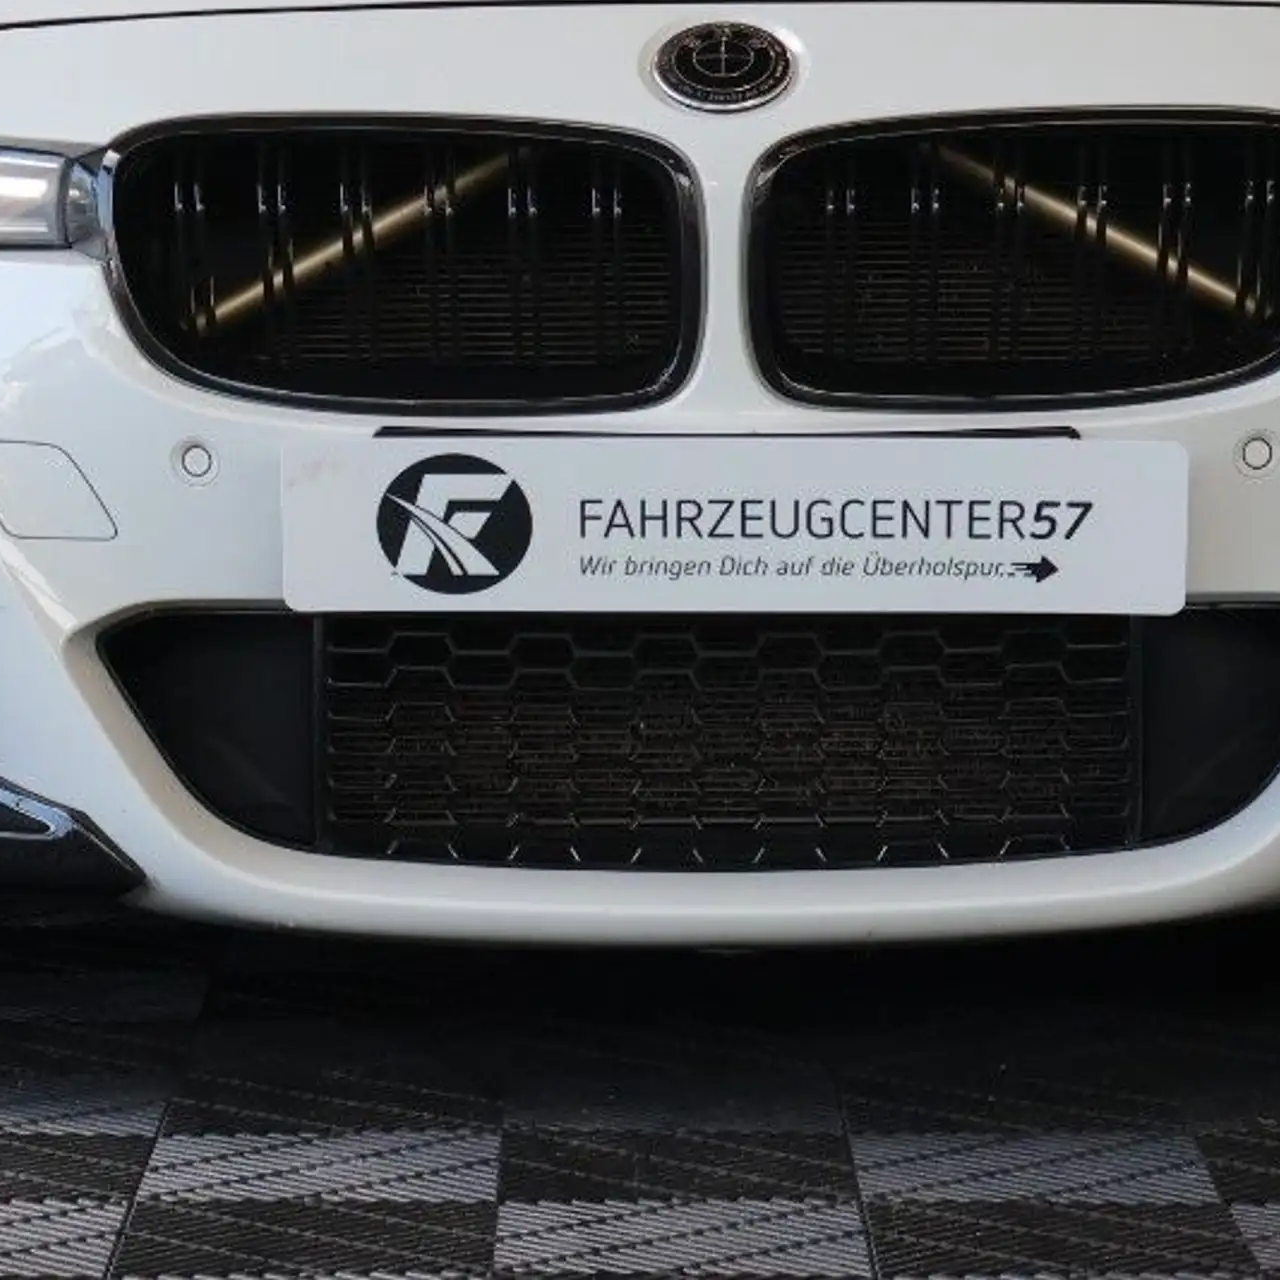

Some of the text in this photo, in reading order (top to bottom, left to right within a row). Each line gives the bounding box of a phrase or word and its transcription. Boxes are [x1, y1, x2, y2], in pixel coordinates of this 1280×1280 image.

[578, 497, 1095, 542] FAHRZEUGCENTER57
[578, 554, 619, 577] Wir
[623, 554, 712, 581] bringen
[718, 554, 769, 578] Dich
[775, 554, 816, 578] auf
[820, 555, 856, 578] die
